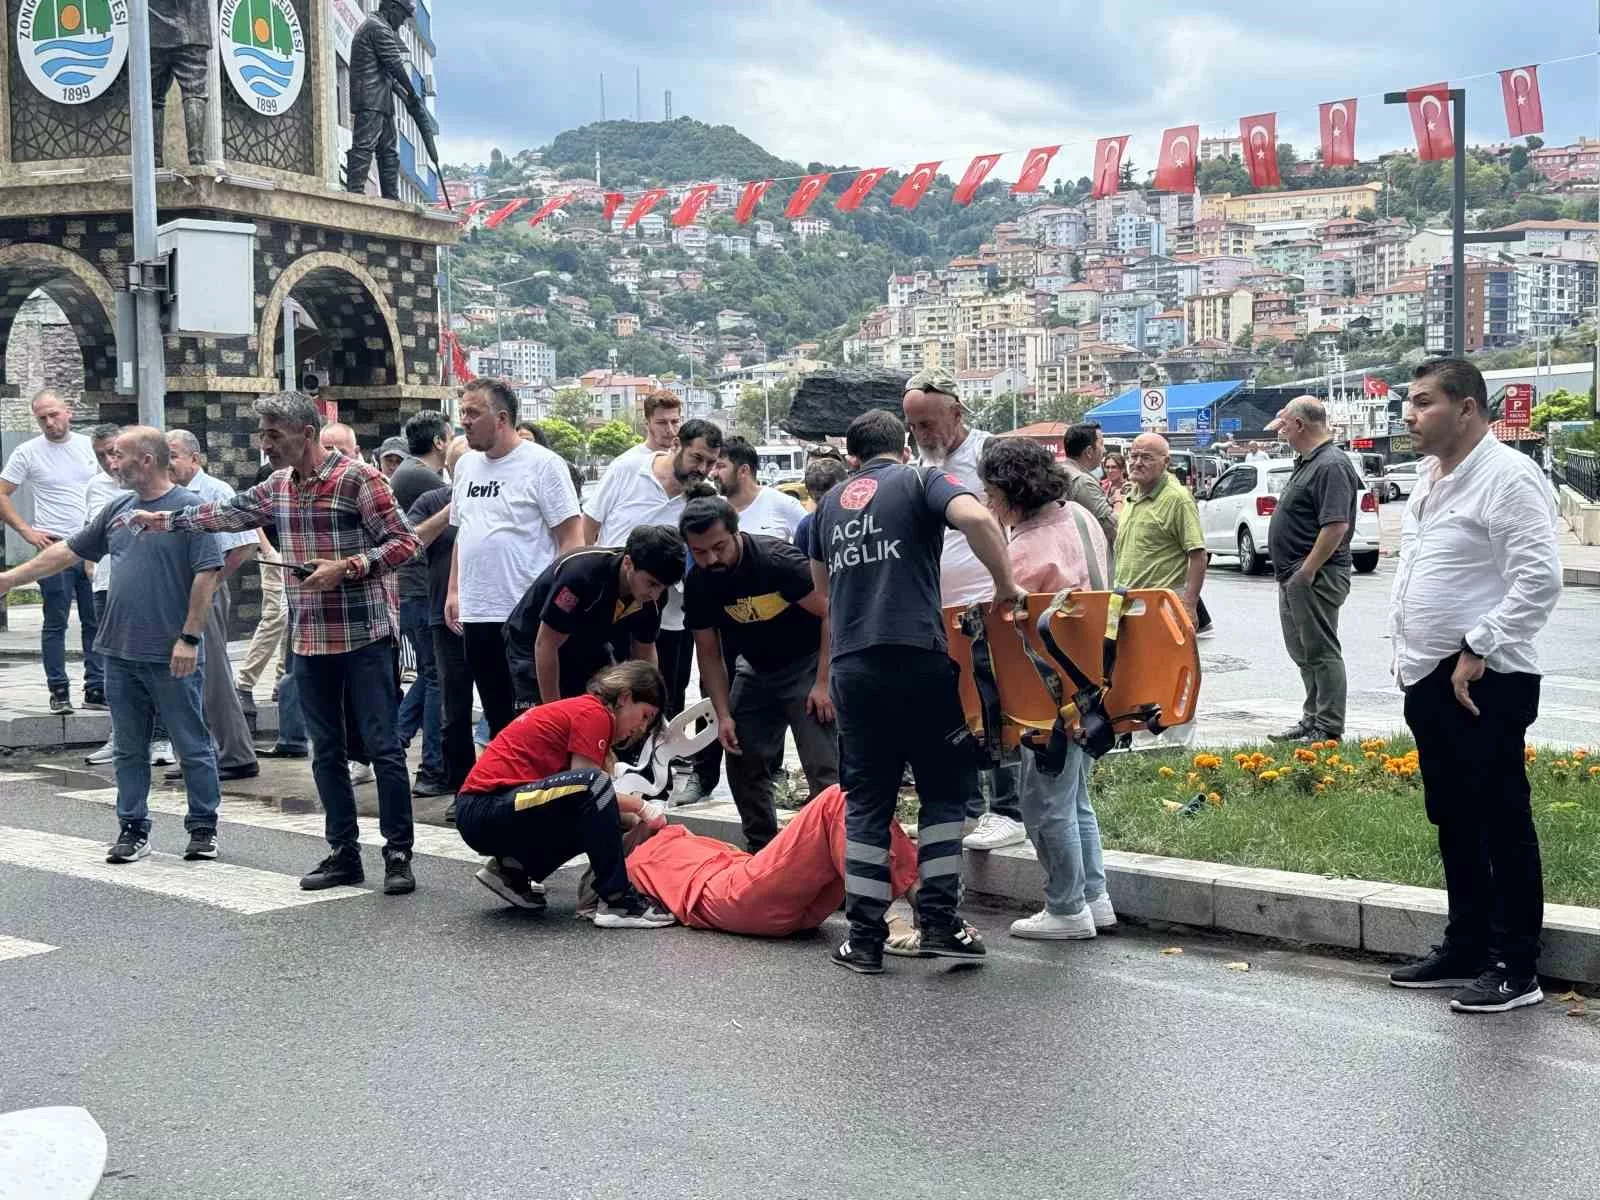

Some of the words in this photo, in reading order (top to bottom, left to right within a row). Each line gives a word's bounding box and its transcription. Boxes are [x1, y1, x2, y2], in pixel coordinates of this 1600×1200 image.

[62, 85, 90, 101] 1899
[256, 97, 277, 112] 1899
[466, 480, 500, 497] levi's
[832, 514, 882, 545] ACİL
